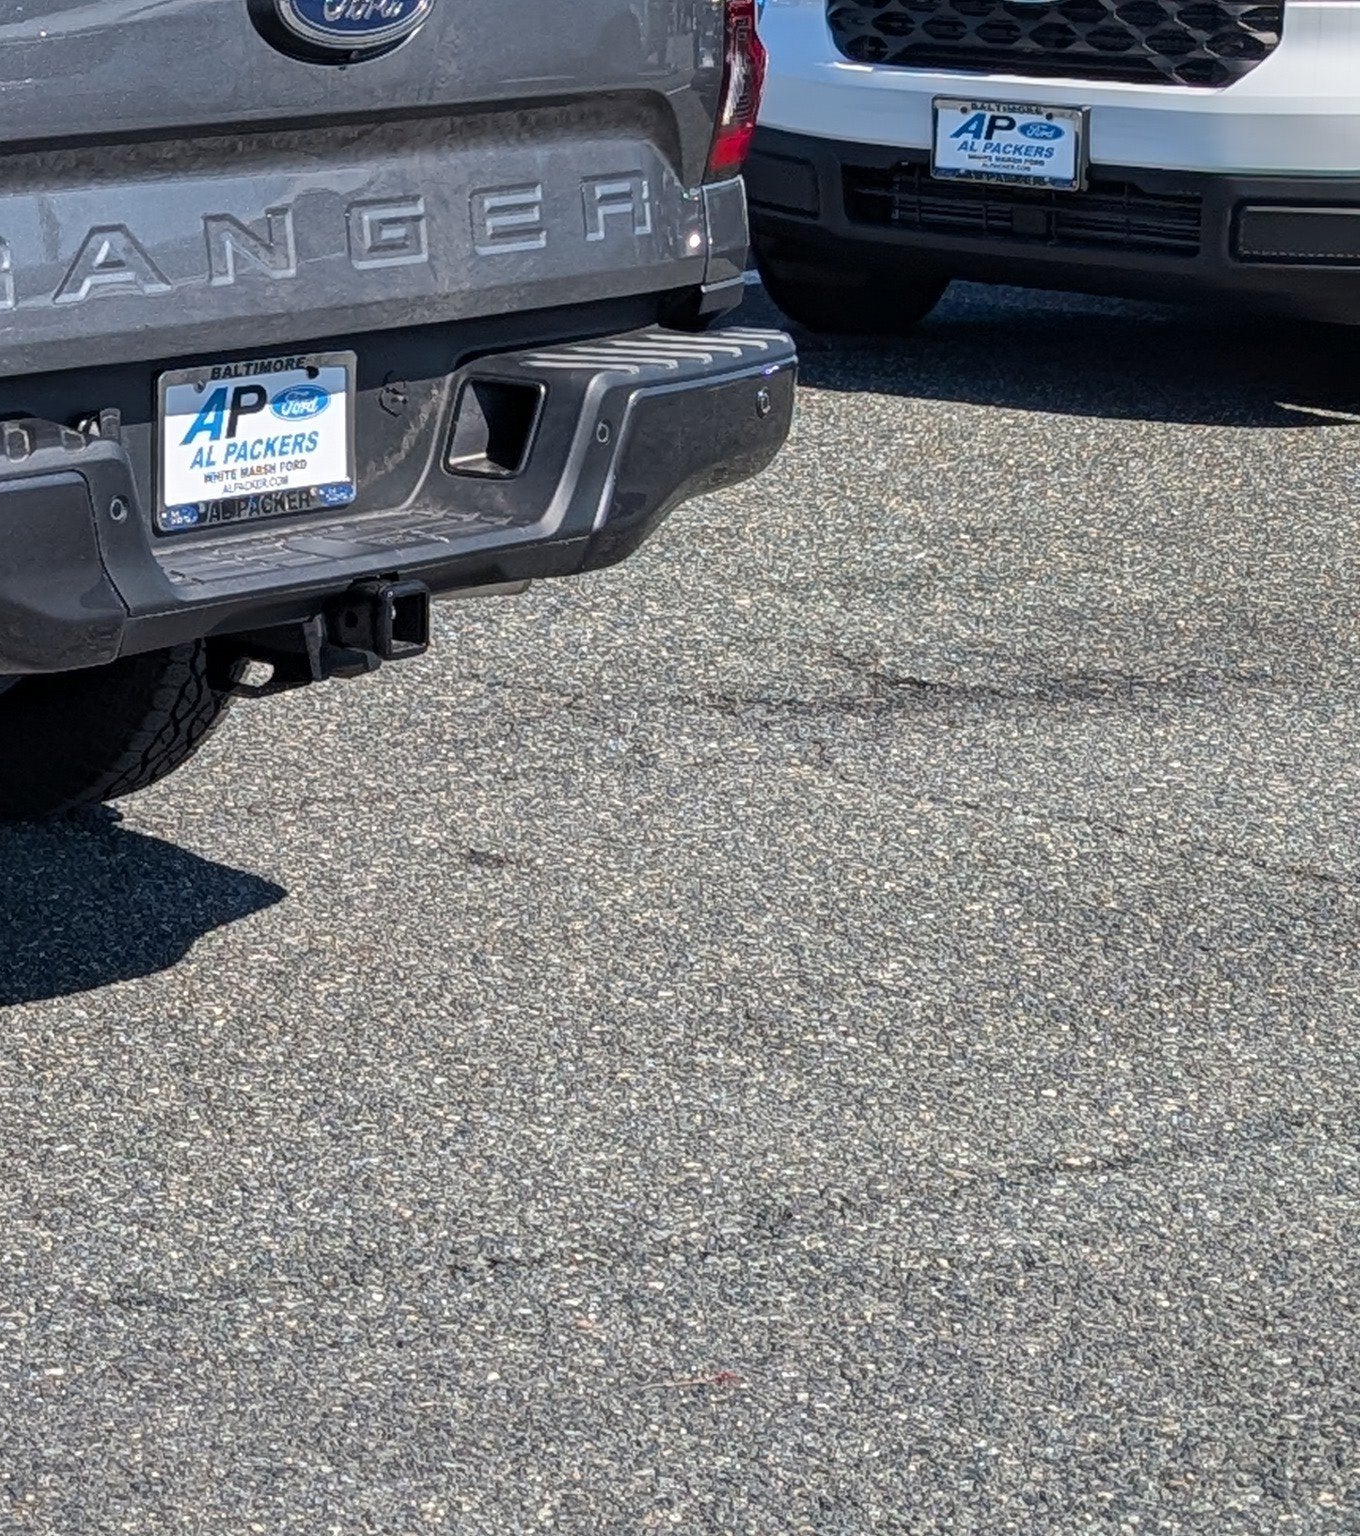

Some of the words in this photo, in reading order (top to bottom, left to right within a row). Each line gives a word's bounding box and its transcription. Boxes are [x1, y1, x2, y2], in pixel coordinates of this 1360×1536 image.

[949, 112, 1017, 141] AP
[957, 140, 978, 152] AL
[982, 142, 1055, 159] PACKERS
[210, 356, 307, 381] BALTIMORE
[180, 384, 267, 446] AP
[190, 446, 217, 470] AL
[223, 430, 320, 465] PACKERS
[203, 466, 237, 483] WHITE
[279, 459, 308, 473] FORD
[235, 488, 311, 518] PACKER
